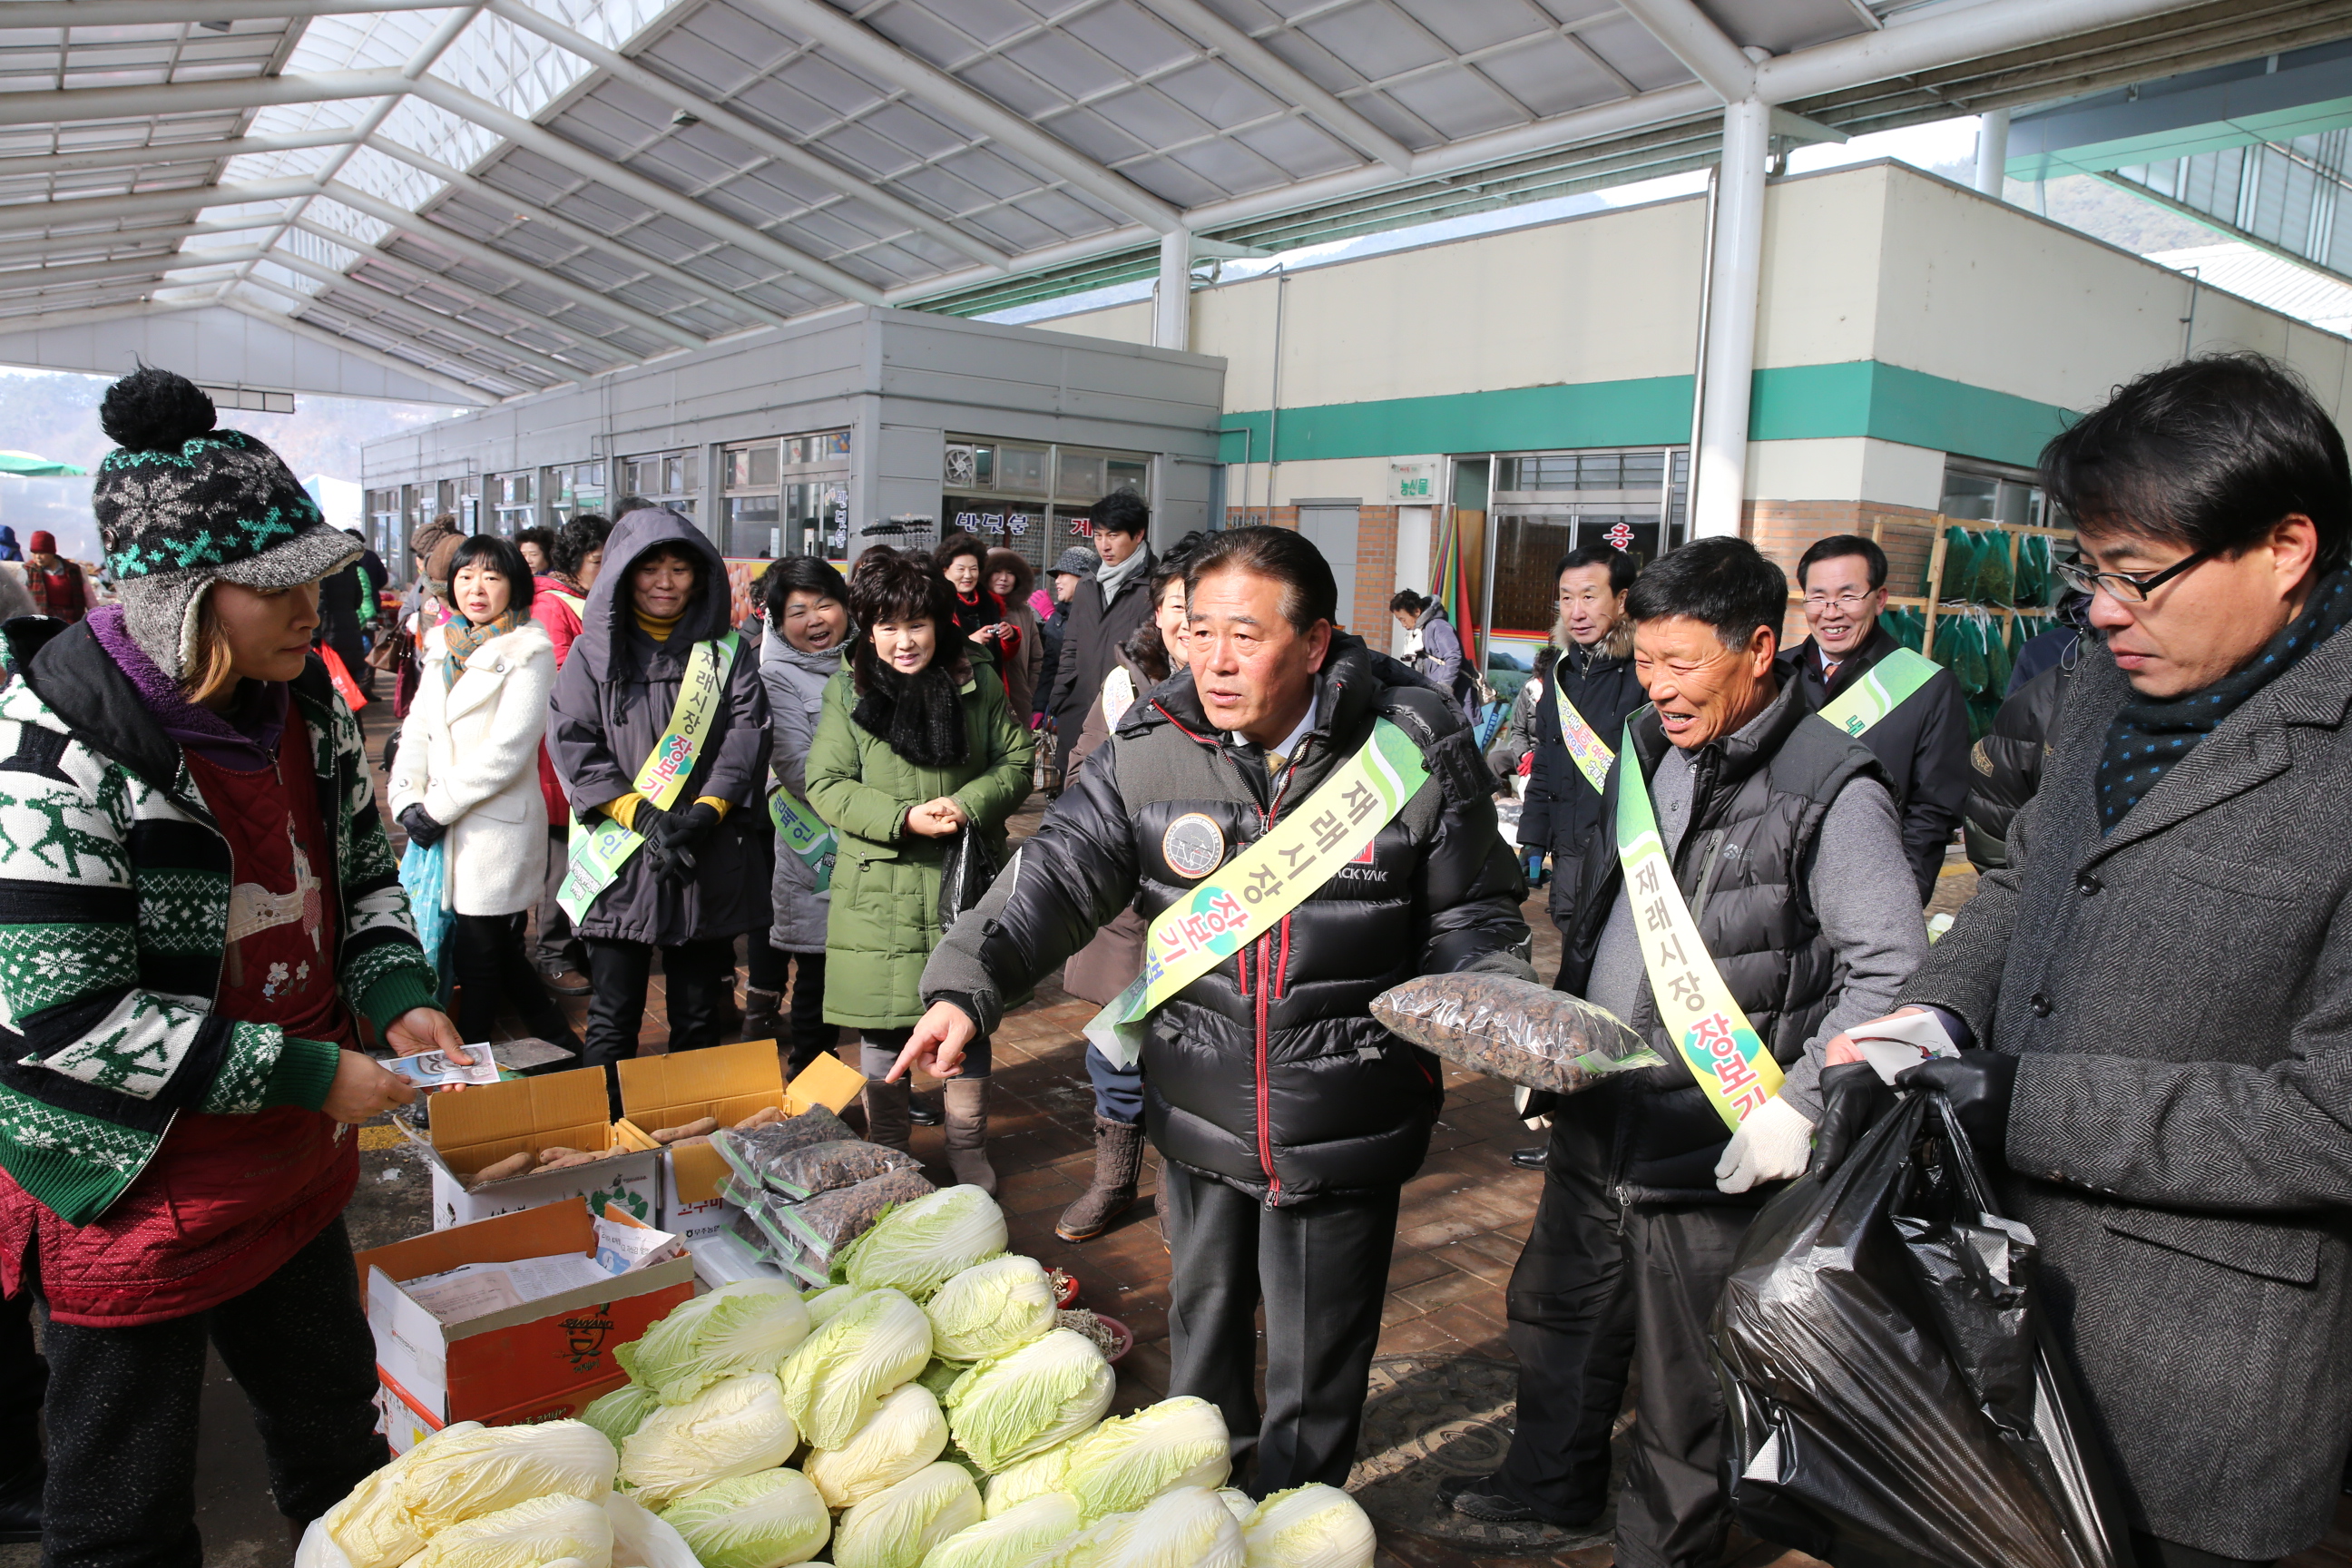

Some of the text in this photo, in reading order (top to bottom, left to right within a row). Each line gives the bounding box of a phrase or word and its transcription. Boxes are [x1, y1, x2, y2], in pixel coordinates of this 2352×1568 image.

[836, 491, 848, 548] 반딧불
[956, 512, 1028, 535] 반딧불
[640, 650, 721, 804] 재래시장 장보기
[1846, 714, 1866, 736] 내
[773, 794, 815, 843] 캠페인
[1243, 779, 1379, 906] 재래시장
[1157, 890, 1250, 965] 장보기
[1636, 860, 1767, 1122] 재래시장 장보기
